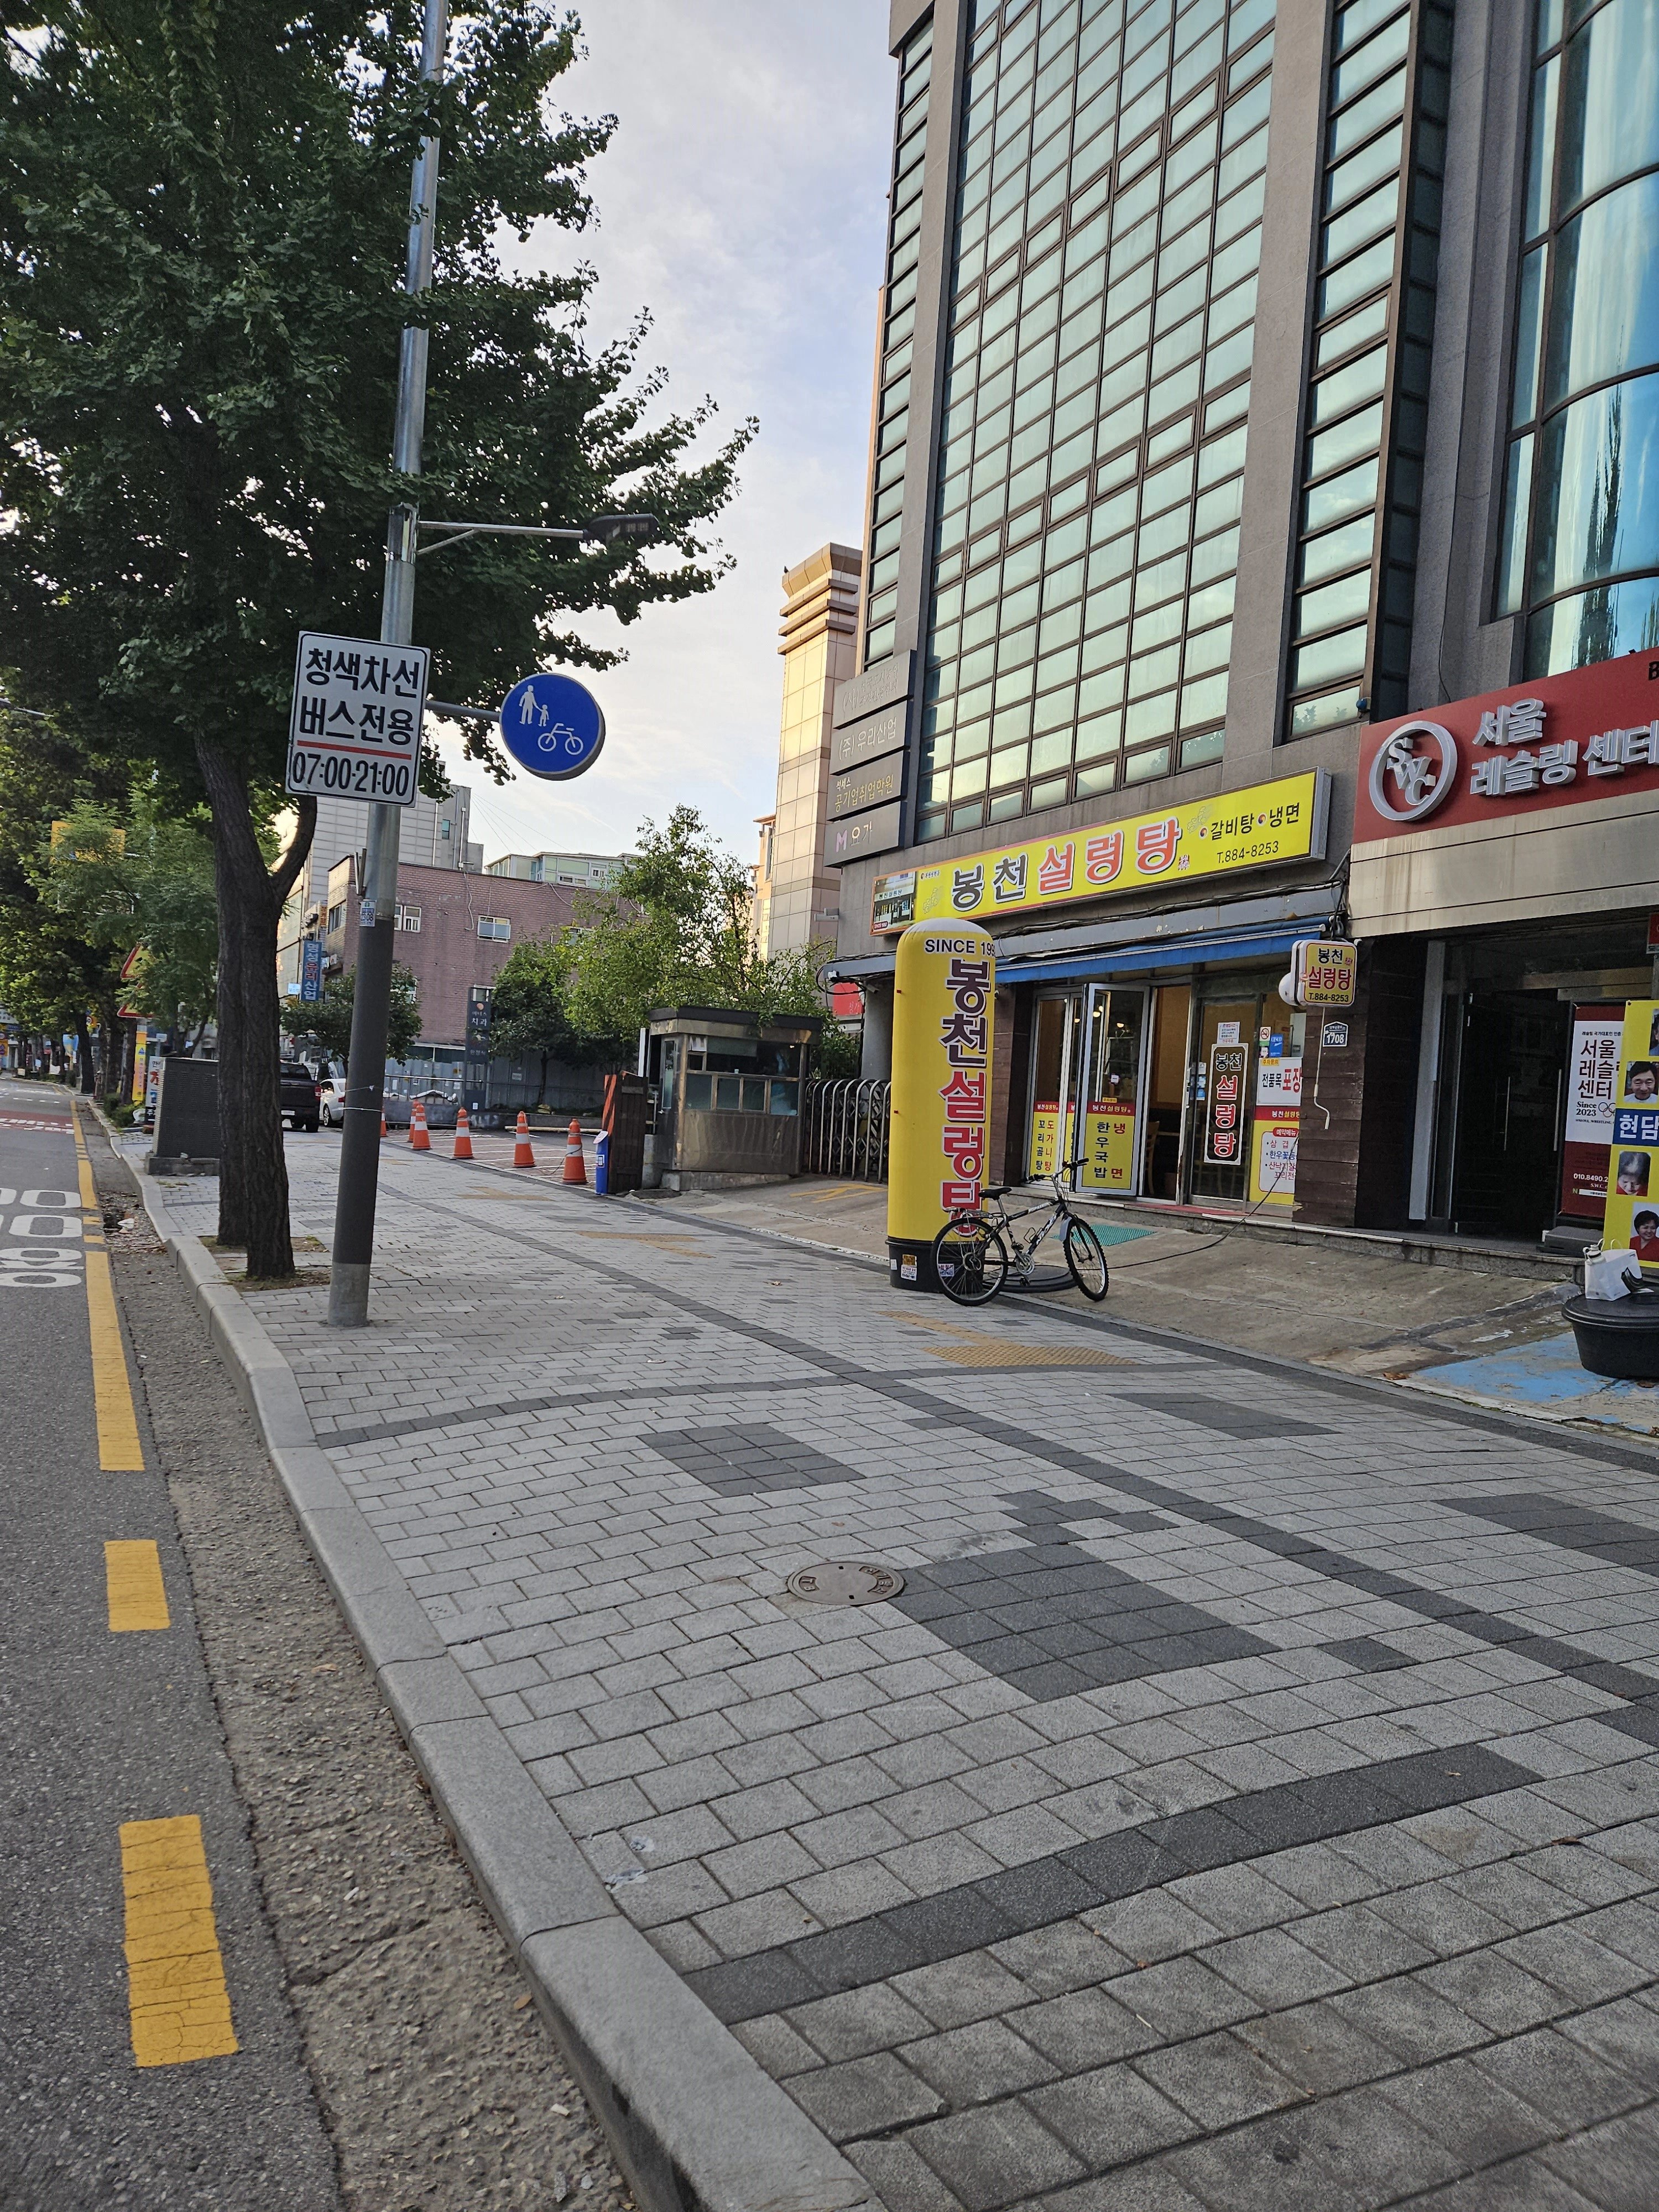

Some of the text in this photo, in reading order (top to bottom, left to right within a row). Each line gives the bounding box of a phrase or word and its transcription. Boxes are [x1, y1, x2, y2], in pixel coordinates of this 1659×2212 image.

[305, 648, 419, 699] 청색차선
[300, 696, 414, 746] 버스전용
[1472, 697, 1547, 747] 서울
[839, 717, 897, 760] (주) 우리산업
[1470, 719, 1659, 796] 레슬링 센터
[834, 774, 894, 813] 공기업취업학원
[836, 776, 852, 791] 석세스
[1211, 802, 1300, 841] 갈비탕 냉면
[836, 821, 873, 853] M 요가
[1217, 841, 1279, 864] T.884-8253
[925, 938, 995, 957] SINCE 199
[1318, 948, 1343, 964] 봉천
[1308, 966, 1352, 990] 설렁탕
[1309, 992, 1349, 1003] T.884-8253
[472, 1018, 487, 1027] 치과
[1327, 1034, 1344, 1044] 1708
[1580, 1040, 1615, 1059] 서울
[1216, 1053, 1242, 1071] 봉천
[1262, 1073, 1282, 1088] 전품목
[1578, 1080, 1612, 1100] 센터
[1214, 1074, 1239, 1157] 설렁탕
[1576, 1108, 1597, 1117] 2023
[1036, 1120, 1045, 1171] 꼬리곰탕
[1045, 1120, 1054, 1171] 도가니탕
[1094, 1121, 1110, 1178] 한우국밥
[1270, 1150, 1296, 1160] 한우꽃등
